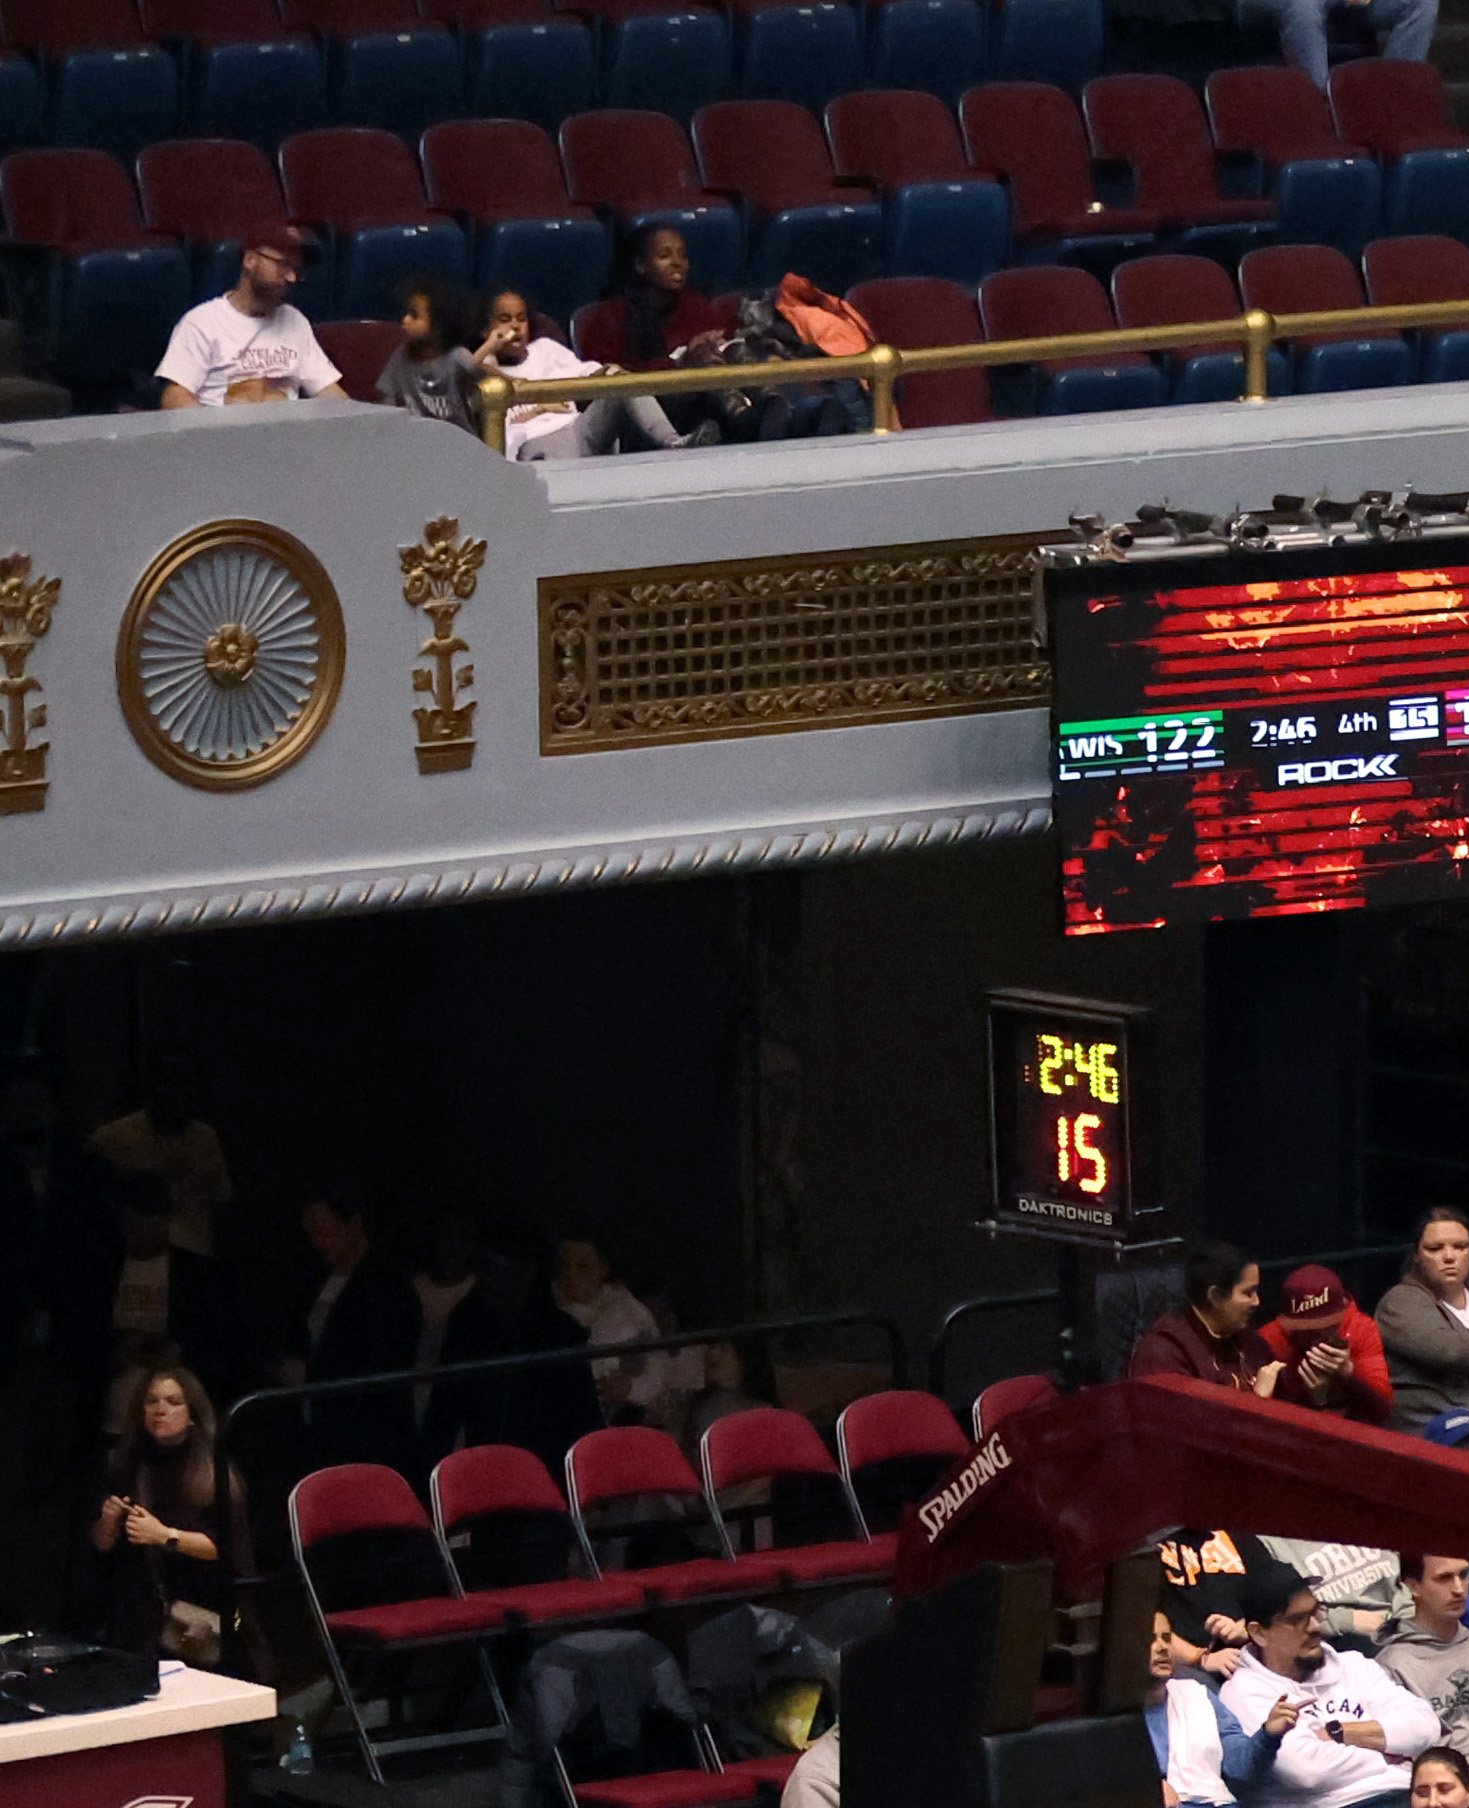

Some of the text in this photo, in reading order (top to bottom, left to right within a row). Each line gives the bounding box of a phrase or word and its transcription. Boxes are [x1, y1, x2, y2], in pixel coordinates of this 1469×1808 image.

[1068, 734, 1124, 759] WIS
[1137, 717, 1217, 763] 122
[1338, 711, 1378, 734] 4th
[1039, 1033, 1120, 1105] 2:46
[1057, 1112, 1108, 1194] 15
[1018, 1198, 1114, 1226] DAKTRONICS
[919, 1431, 1013, 1543] SPALDING
[1304, 1542, 1382, 1583] OHIO
